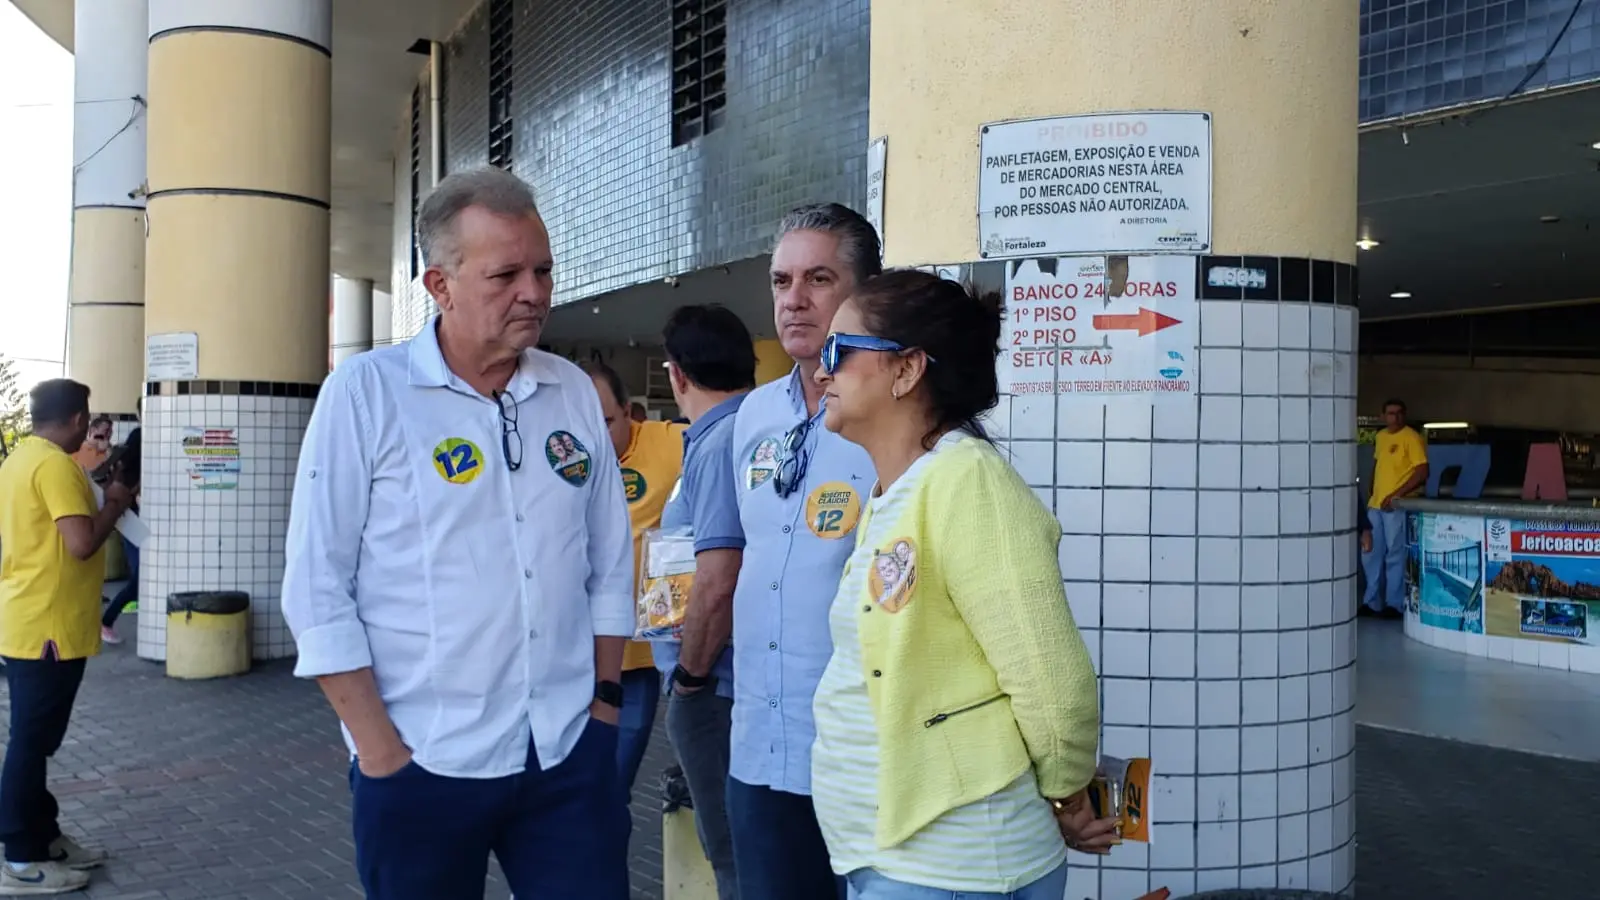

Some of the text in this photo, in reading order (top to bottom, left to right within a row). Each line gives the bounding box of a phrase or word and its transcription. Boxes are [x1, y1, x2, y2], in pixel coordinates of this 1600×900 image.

[1038, 121, 1148, 140] PROIBIDO
[986, 144, 1200, 169] PANFLETAGEM, EXPOSIÇÃO E VENDA
[1001, 160, 1184, 184] DE MERCADORIAS NESTA ÁREA
[1020, 181, 1163, 199] DO MERCADO CENTRAL,
[995, 197, 1189, 218] POR PESSOAS NÃO AUTORIZADA.
[1005, 241, 1046, 250] Fortaleza
[1013, 281, 1177, 301] BANCO 24 ORAS
[1034, 306, 1076, 322] PISO
[1034, 328, 1076, 344] PISO
[1013, 351, 1073, 367] SETOR
[1131, 381, 1158, 392] ELEVADOR
[436, 443, 478, 478] 12
[816, 510, 843, 532] 12
[1127, 782, 1141, 818] 12
